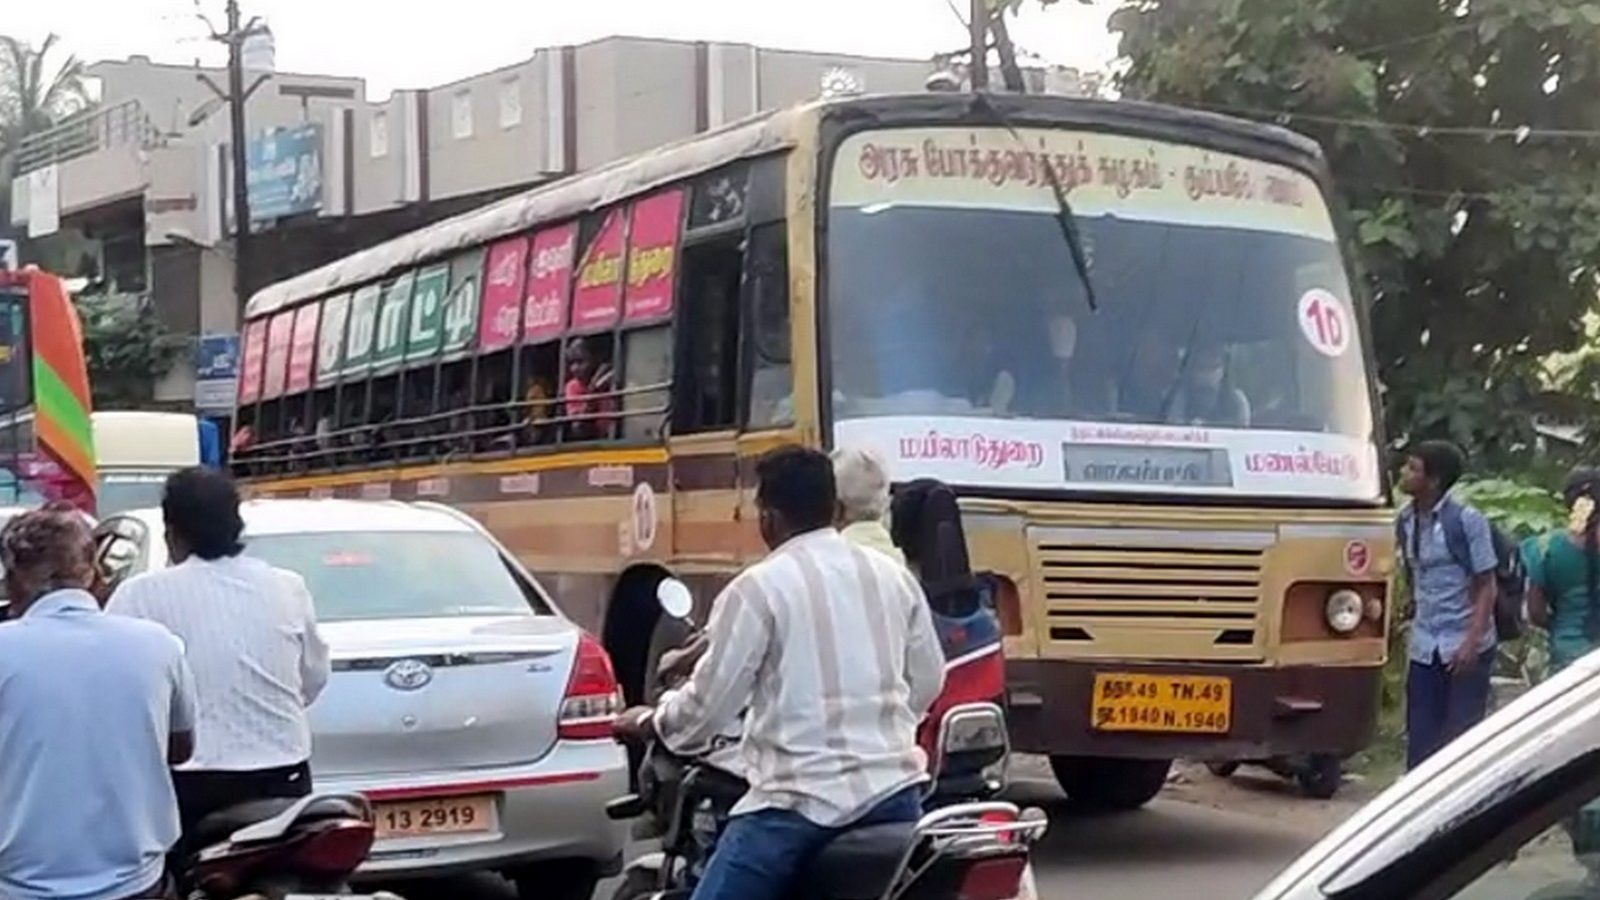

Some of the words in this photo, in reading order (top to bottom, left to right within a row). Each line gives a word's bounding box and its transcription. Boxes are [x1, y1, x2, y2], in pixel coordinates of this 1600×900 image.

[859, 143, 918, 182] அரசு
[1306, 298, 1342, 348] 1D
[898, 430, 1044, 469] மயிலாடுதுறை
[1170, 682, 1224, 702] TN.49
[1164, 710, 1226, 729] N.1940
[386, 810, 412, 830] 13
[420, 805, 475, 828] 2919
